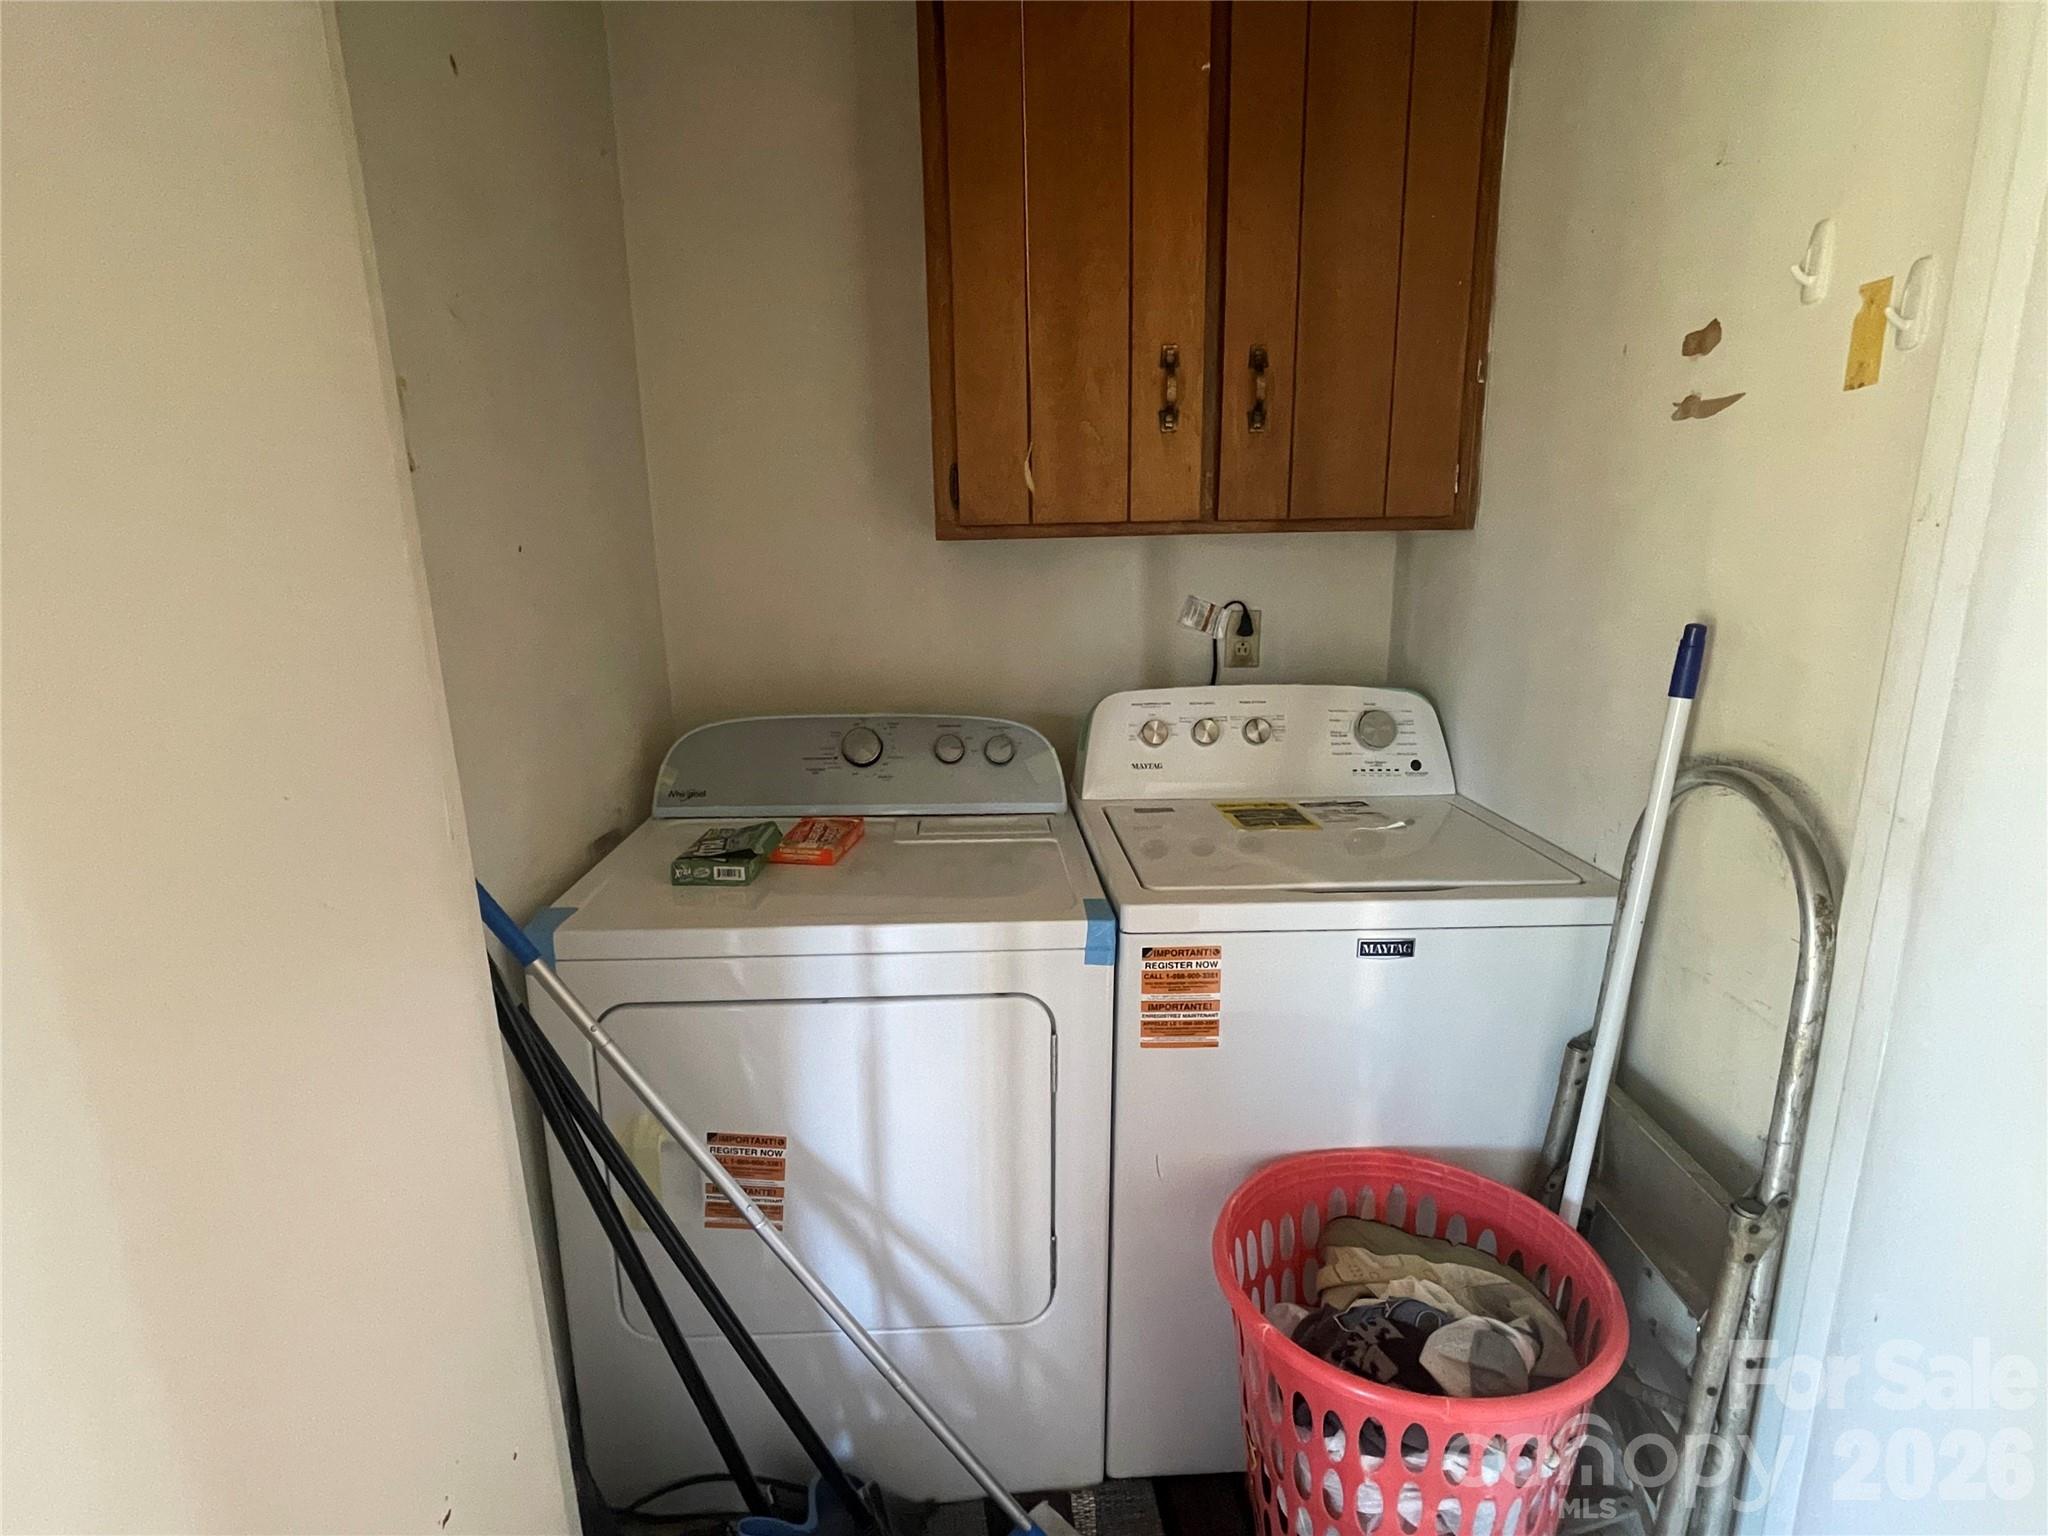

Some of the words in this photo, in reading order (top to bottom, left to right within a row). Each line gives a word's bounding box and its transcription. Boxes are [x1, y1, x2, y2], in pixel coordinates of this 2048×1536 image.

[1131, 762, 1163, 770] MAYTAG
[1153, 948, 1212, 958] IMPORTANT!
[1362, 943, 1412, 954] MAYTAG
[1145, 961, 1193, 970] REGISTER
[1196, 961, 1218, 969] NOW
[1148, 1002, 1213, 1011] IMPORTANTE!
[710, 1146, 758, 1156] REGISTER
[760, 1149, 783, 1157] NOW
